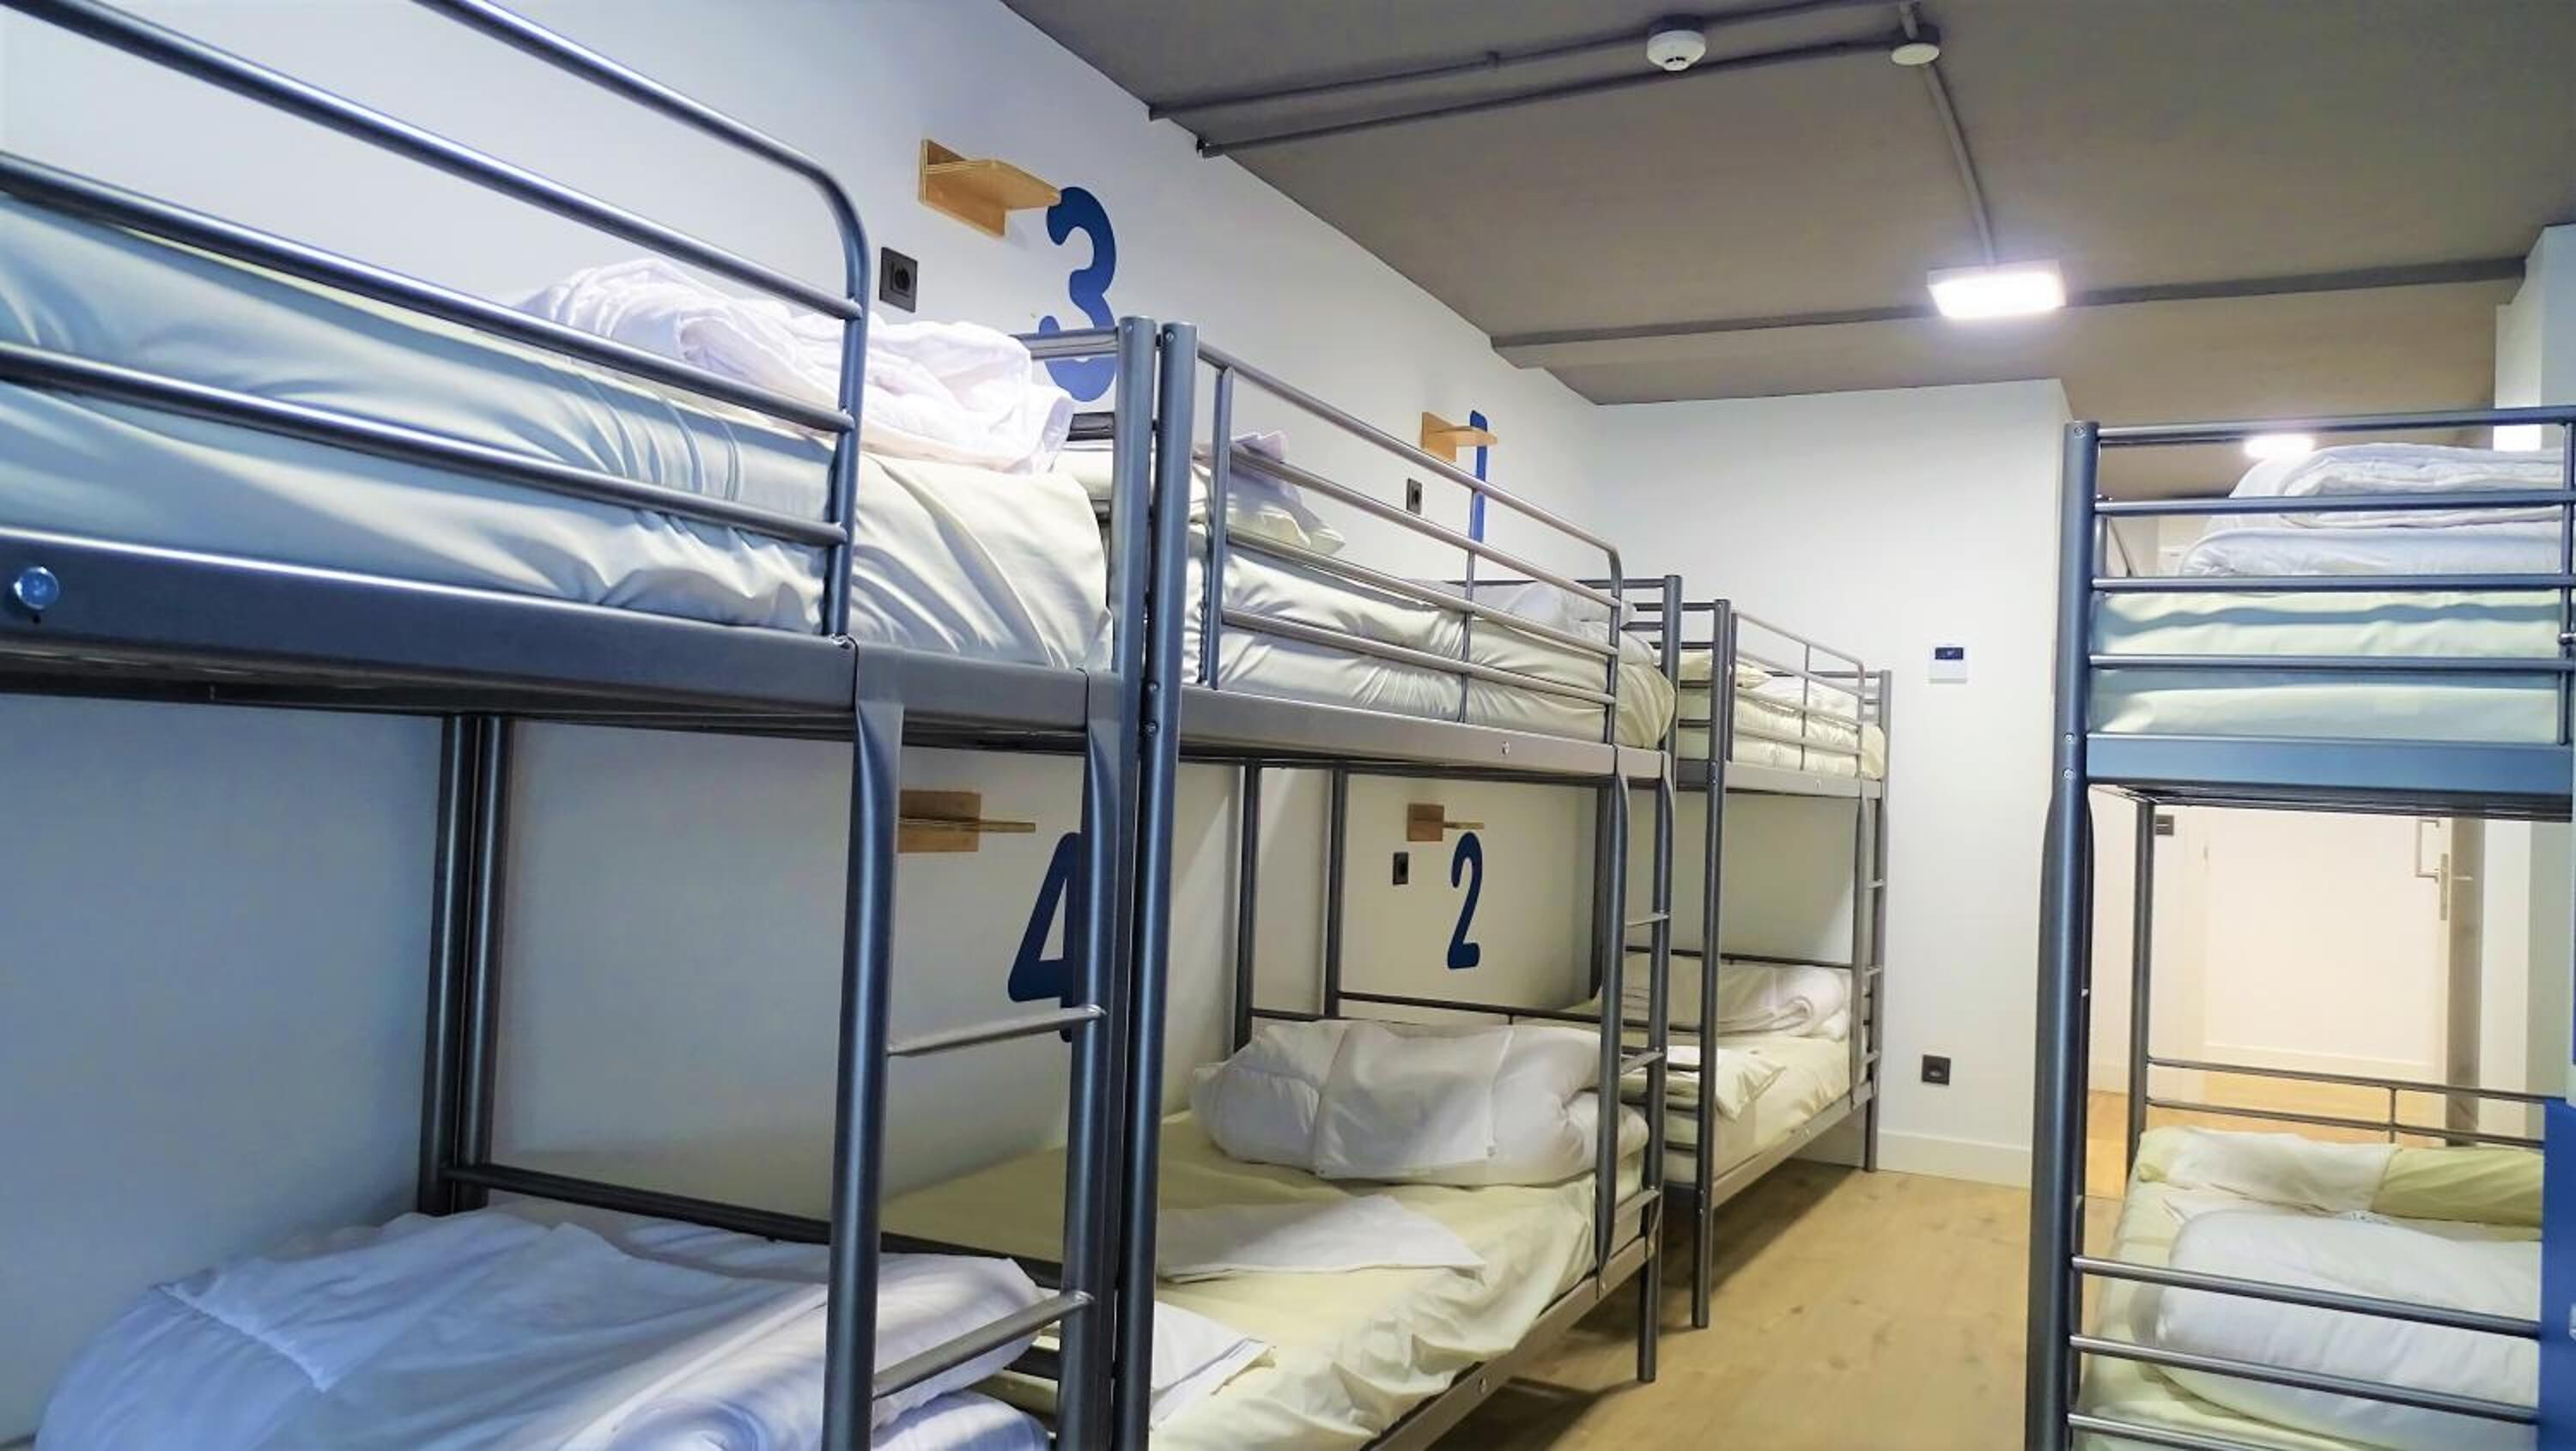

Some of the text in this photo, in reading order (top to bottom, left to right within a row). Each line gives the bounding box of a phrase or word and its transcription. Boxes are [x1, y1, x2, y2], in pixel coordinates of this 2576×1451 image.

[1039, 186, 1115, 401] 3
[1008, 832, 1081, 1041] 4
[1448, 831, 1482, 968] 2
